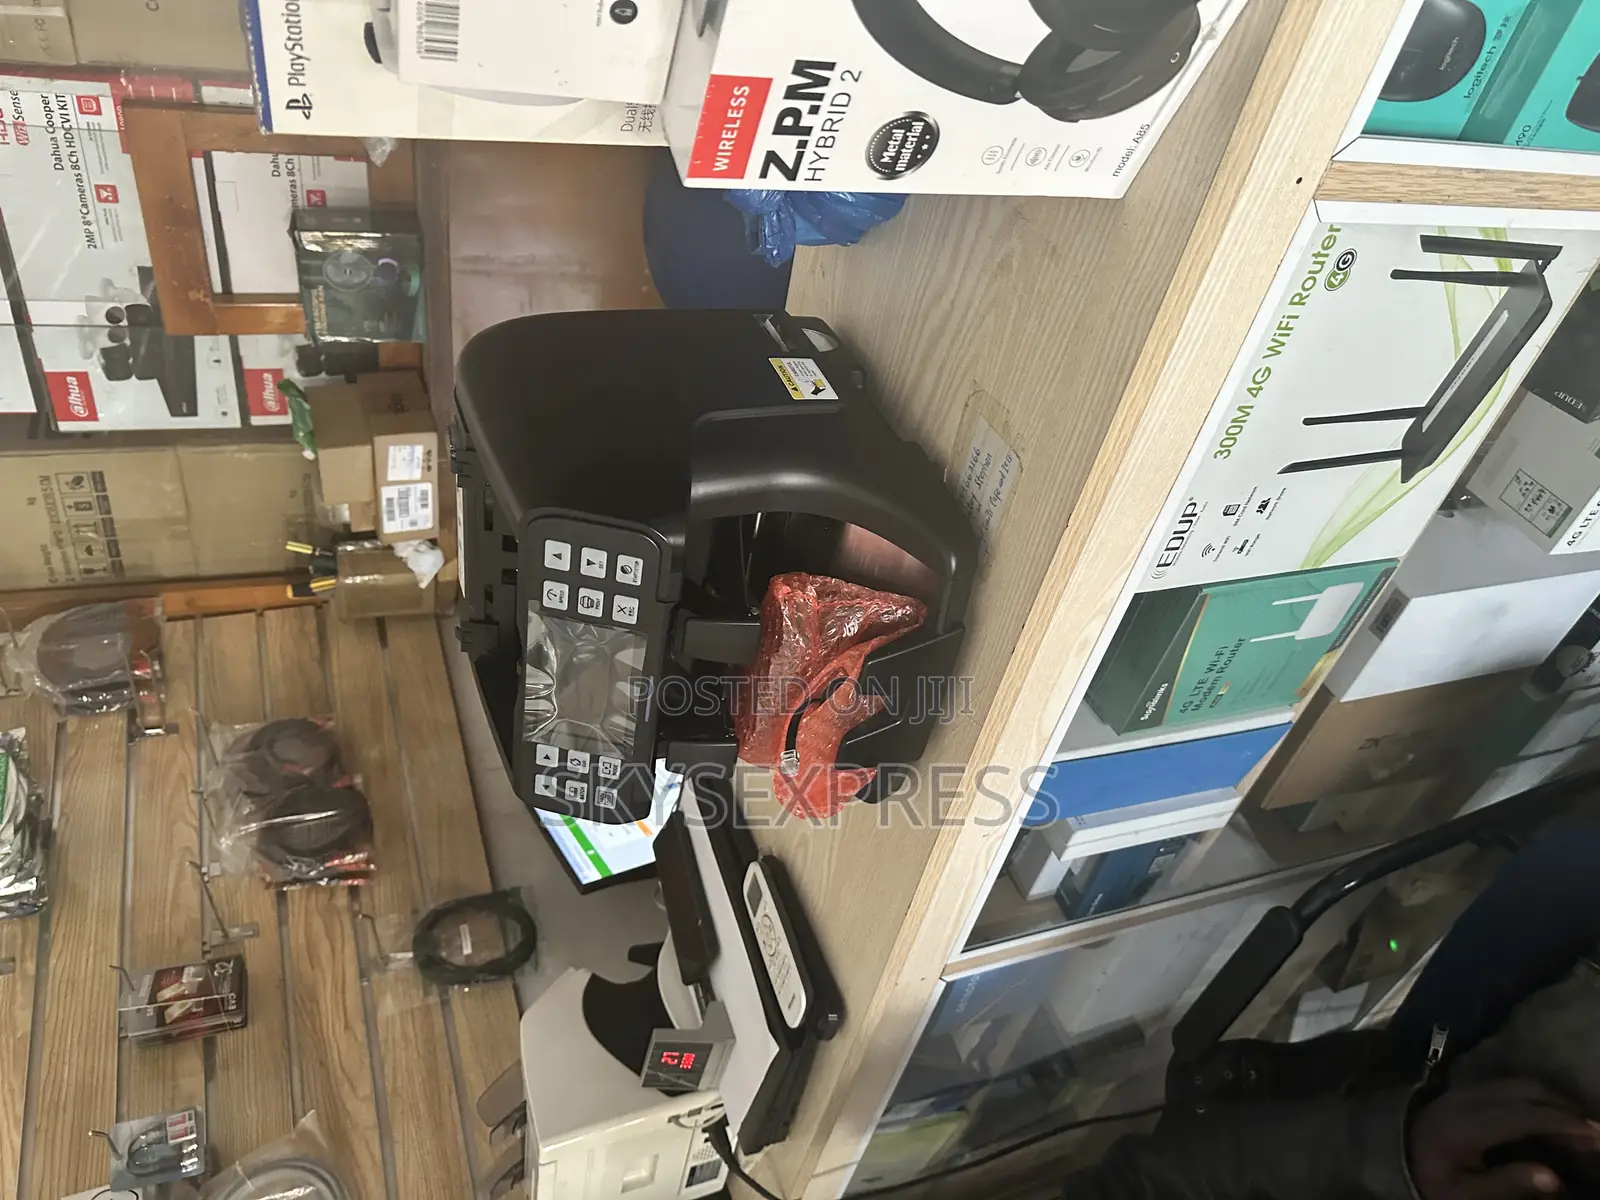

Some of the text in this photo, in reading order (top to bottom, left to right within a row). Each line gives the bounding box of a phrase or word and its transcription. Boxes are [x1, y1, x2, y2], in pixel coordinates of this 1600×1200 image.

[281, 0, 312, 86] PlayStatio
[1438, 36, 1460, 70] logitech
[1462, 46, 1497, 99] logitech
[55, 94, 69, 110] KIT
[758, 59, 837, 182] Z.P.M
[804, 70, 862, 182] HYBRID 2
[40, 94, 64, 171] Dahua Cooper
[58, 112, 76, 148] HDCVI
[712, 86, 750, 172] WIRELESS
[880, 130, 906, 162] Metal
[894, 122, 924, 172] material
[1112, 123, 1150, 178] model: A85
[68, 150, 80, 170] 8Ch
[284, 158, 296, 177] 8Ch
[84, 228, 97, 250] 2MP
[1212, 224, 1342, 460] 300M 4G WiFi Router
[778, 365, 795, 386] CAUTION
[1554, 390, 1584, 409] EDUP
[1156, 502, 1198, 568] EDUP
[1566, 530, 1583, 546] 4G
[1578, 510, 1599, 528] LTE
[1180, 700, 1194, 714] 4G
[1190, 678, 1210, 696] LTE
[1204, 646, 1228, 674] Wi-Fi
[1190, 676, 1222, 712] Modem
[1216, 638, 1245, 674] Router
